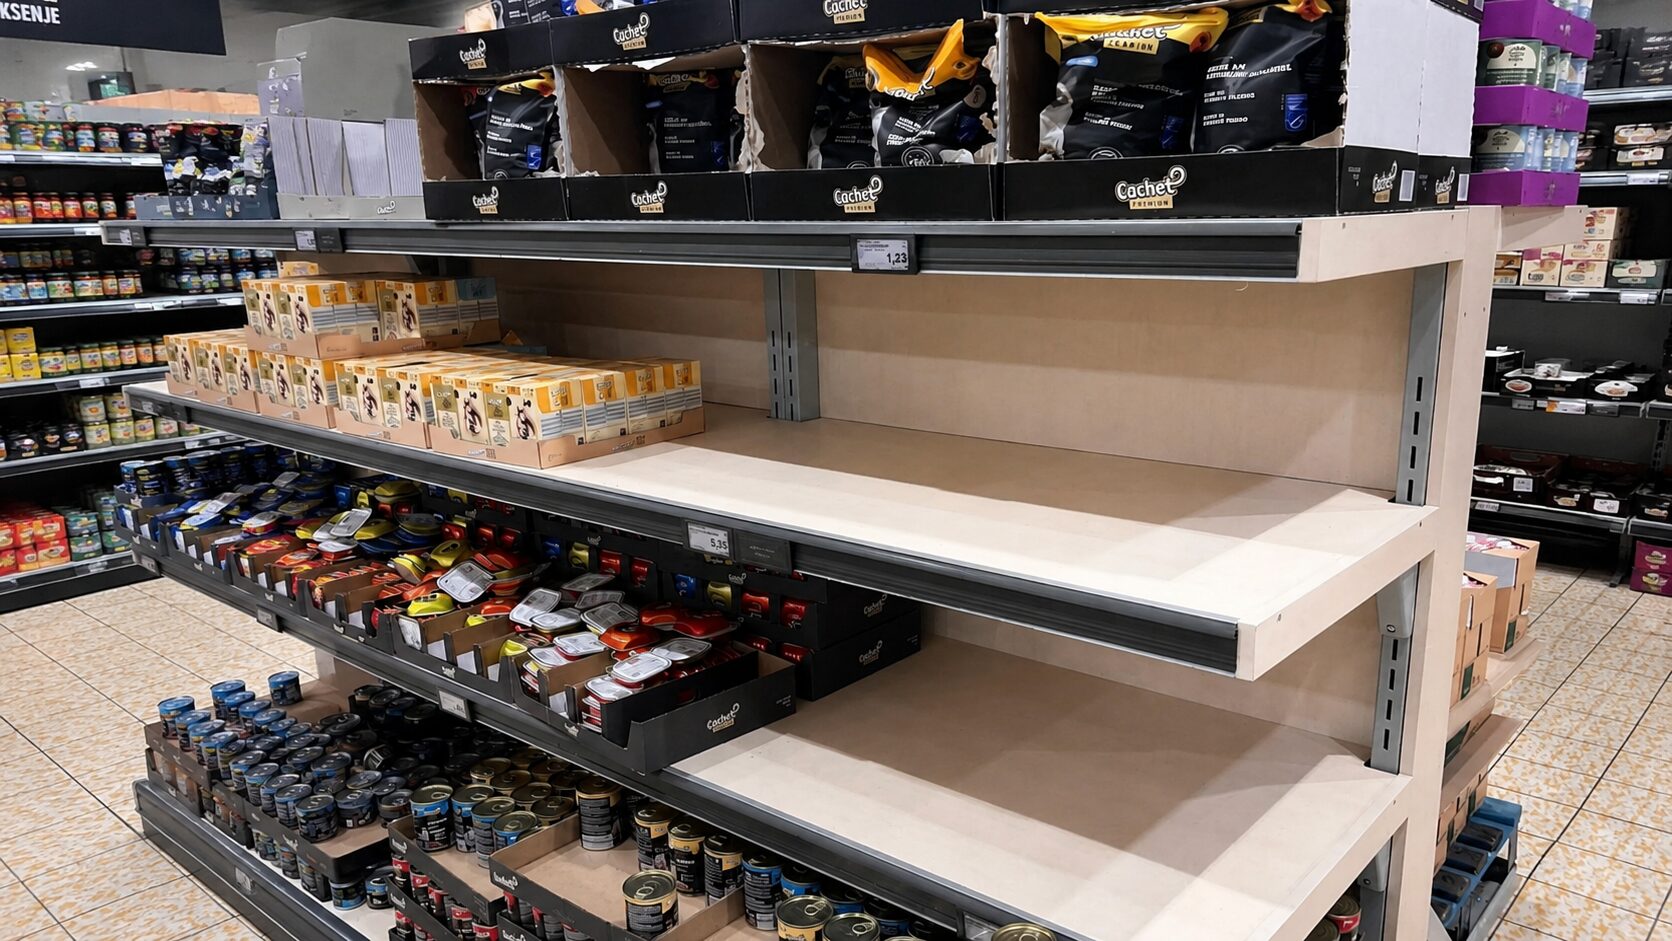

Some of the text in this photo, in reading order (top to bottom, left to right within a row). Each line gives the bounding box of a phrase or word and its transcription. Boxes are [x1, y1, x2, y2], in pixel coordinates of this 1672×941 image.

[631, 180, 667, 207] Cachet
[833, 175, 883, 206] Cachet
[1115, 165, 1187, 202] Cachet
[886, 252, 908, 266] 1,23
